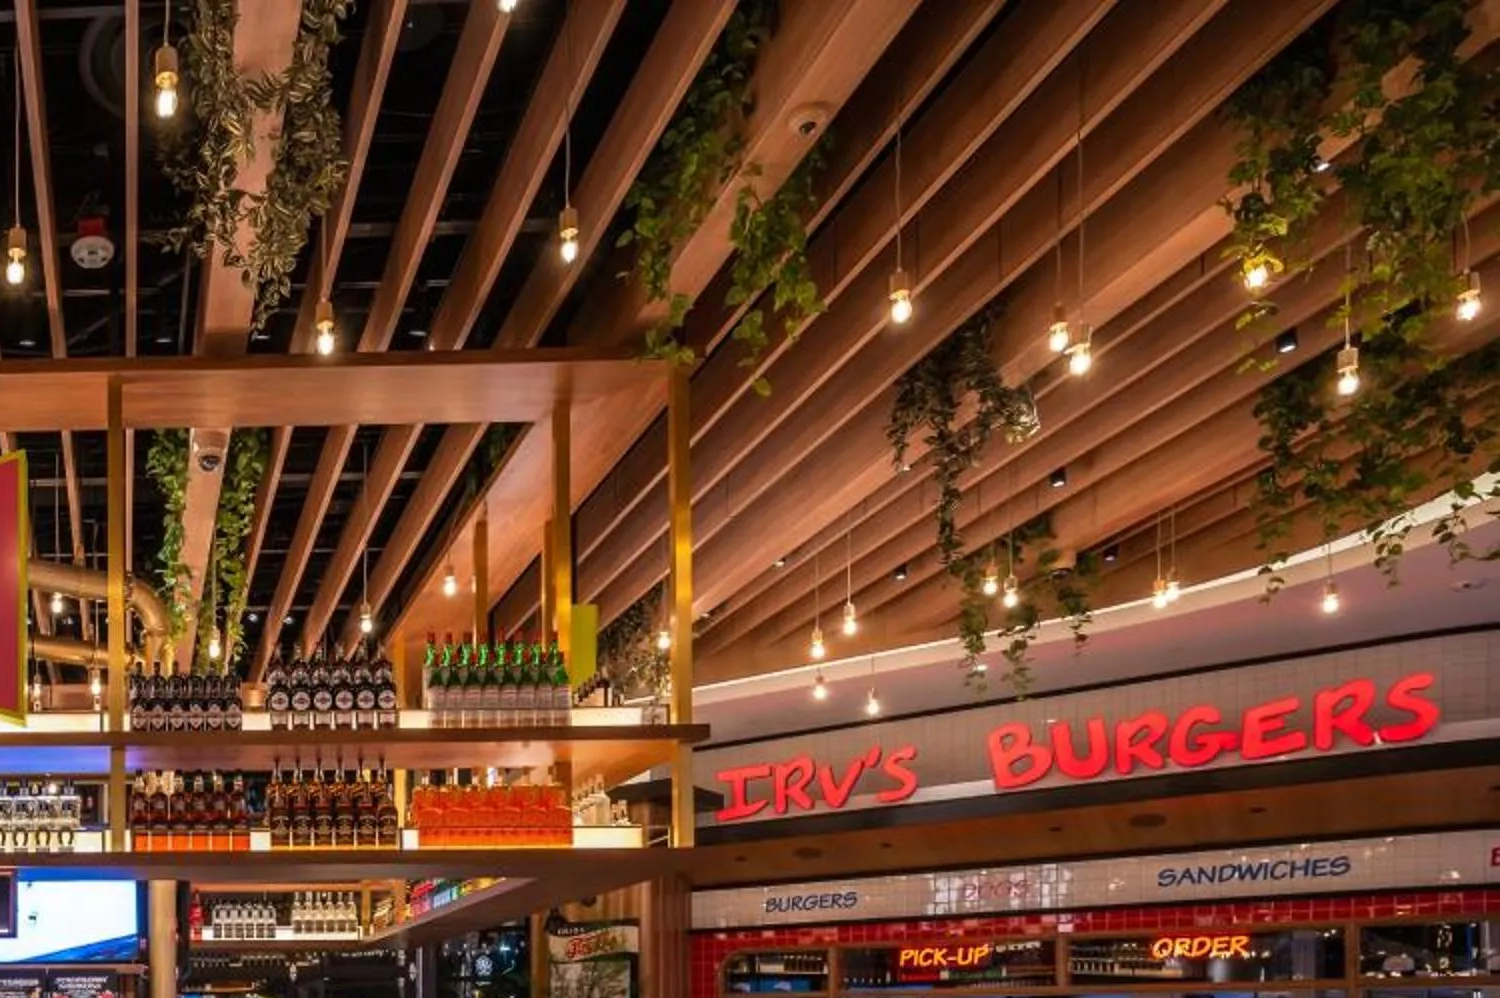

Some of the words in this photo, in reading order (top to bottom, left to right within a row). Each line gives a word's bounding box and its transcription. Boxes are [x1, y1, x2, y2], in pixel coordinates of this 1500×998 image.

[714, 745, 919, 822] IRV'S
[988, 671, 1441, 790] BURGERS
[1157, 855, 1351, 887] SANDWICHES
[765, 891, 858, 913] BURGERS
[900, 944, 990, 967] PICK-UP
[1152, 935, 1250, 959] ORDER
